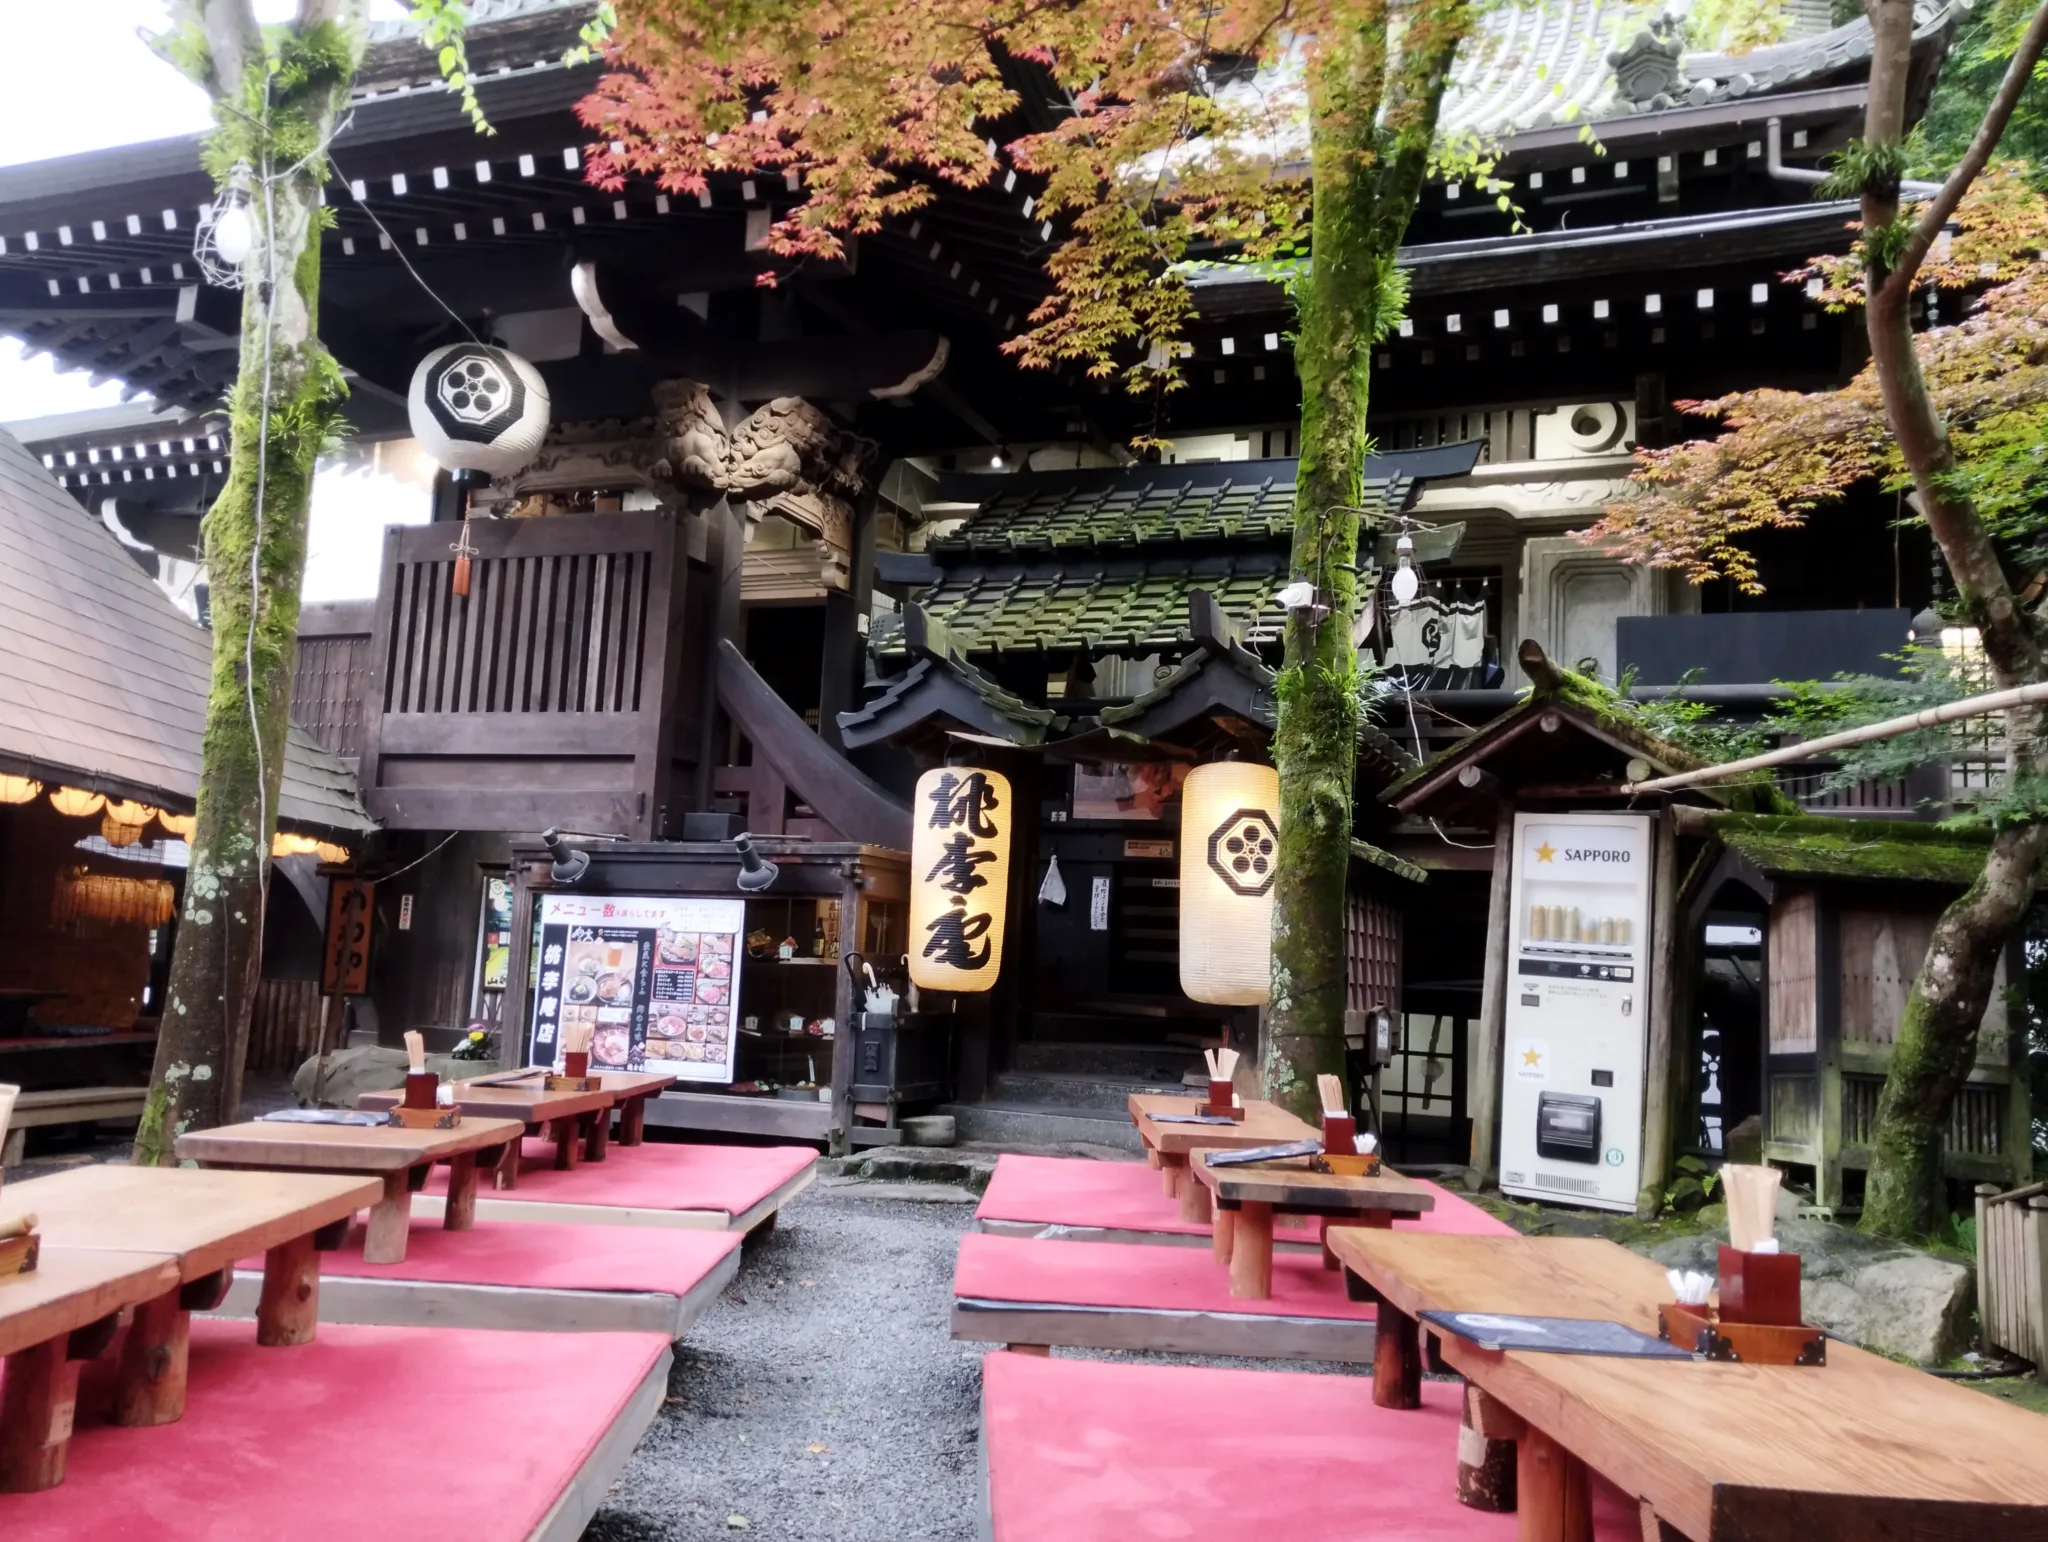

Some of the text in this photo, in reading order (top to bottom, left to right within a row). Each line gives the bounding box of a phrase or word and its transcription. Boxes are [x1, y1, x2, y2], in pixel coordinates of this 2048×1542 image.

[923, 772, 999, 970] 桃李庵
[1564, 848, 1631, 863] SAPPORO
